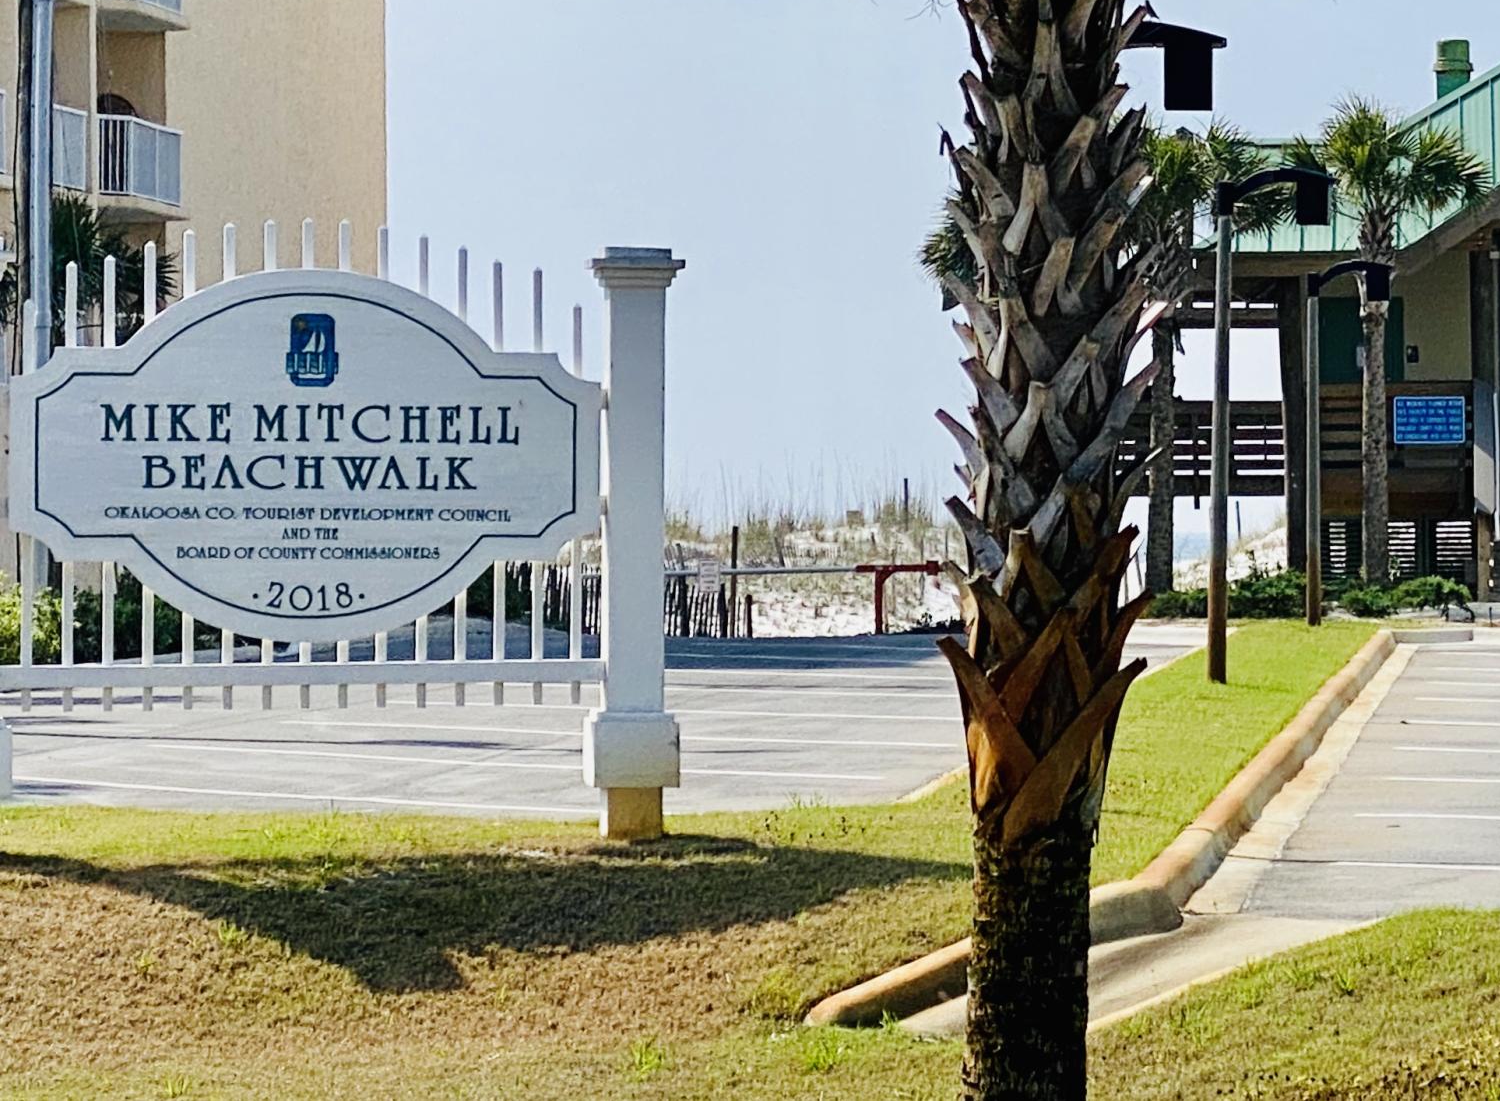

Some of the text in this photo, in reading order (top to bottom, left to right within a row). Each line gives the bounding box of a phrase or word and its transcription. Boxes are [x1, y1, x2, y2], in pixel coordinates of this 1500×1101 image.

[100, 402, 519, 445] MIKE MITCHELL
[142, 454, 477, 491] BEACHWALK
[104, 506, 511, 522] OKALOOSA CO. TOURIST DEVELOPMENT COUNCIL
[282, 528, 339, 541] AND THE
[176, 546, 440, 560] BOARD OF COUNTY COMMISSIONERS
